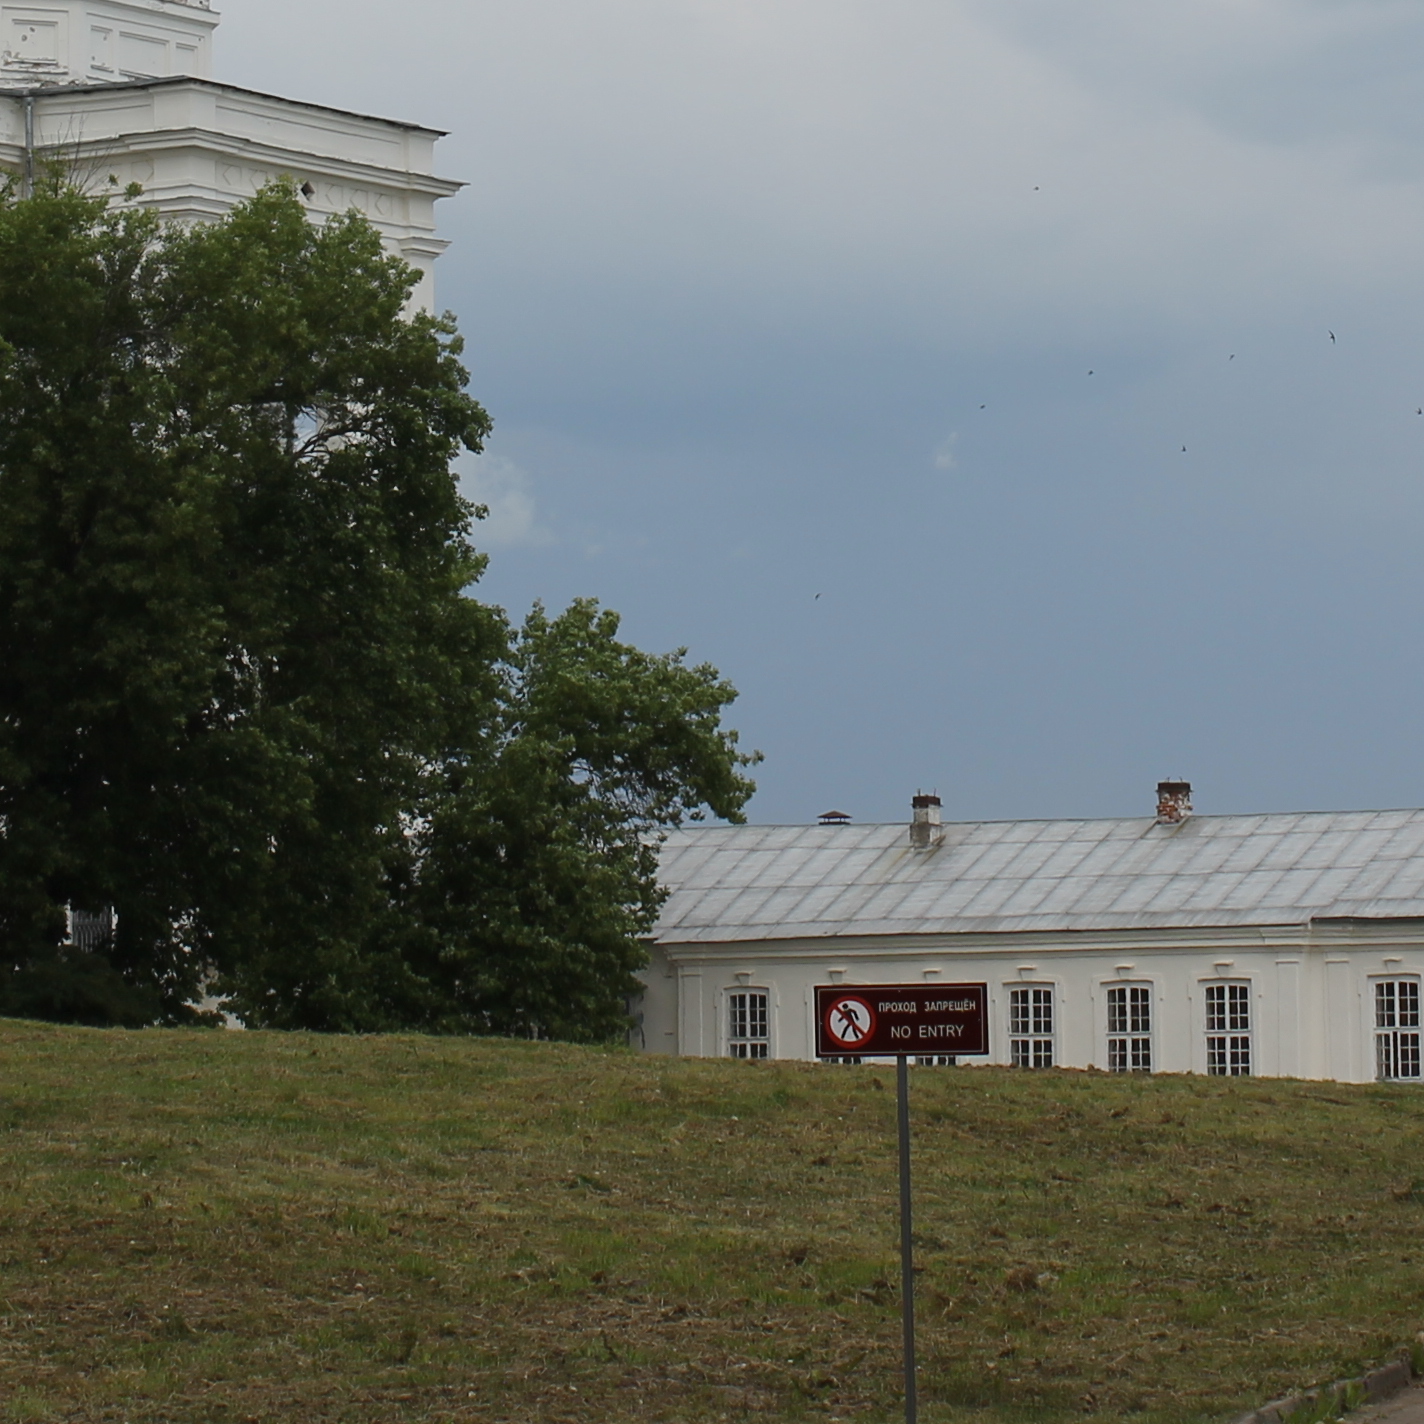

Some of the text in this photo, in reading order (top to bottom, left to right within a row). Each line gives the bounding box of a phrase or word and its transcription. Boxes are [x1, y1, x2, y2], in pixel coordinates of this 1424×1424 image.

[878, 999, 976, 1013] ПРОХОД ЗАПРЕЩЁН
[891, 1025, 964, 1038] NO ENTRY
